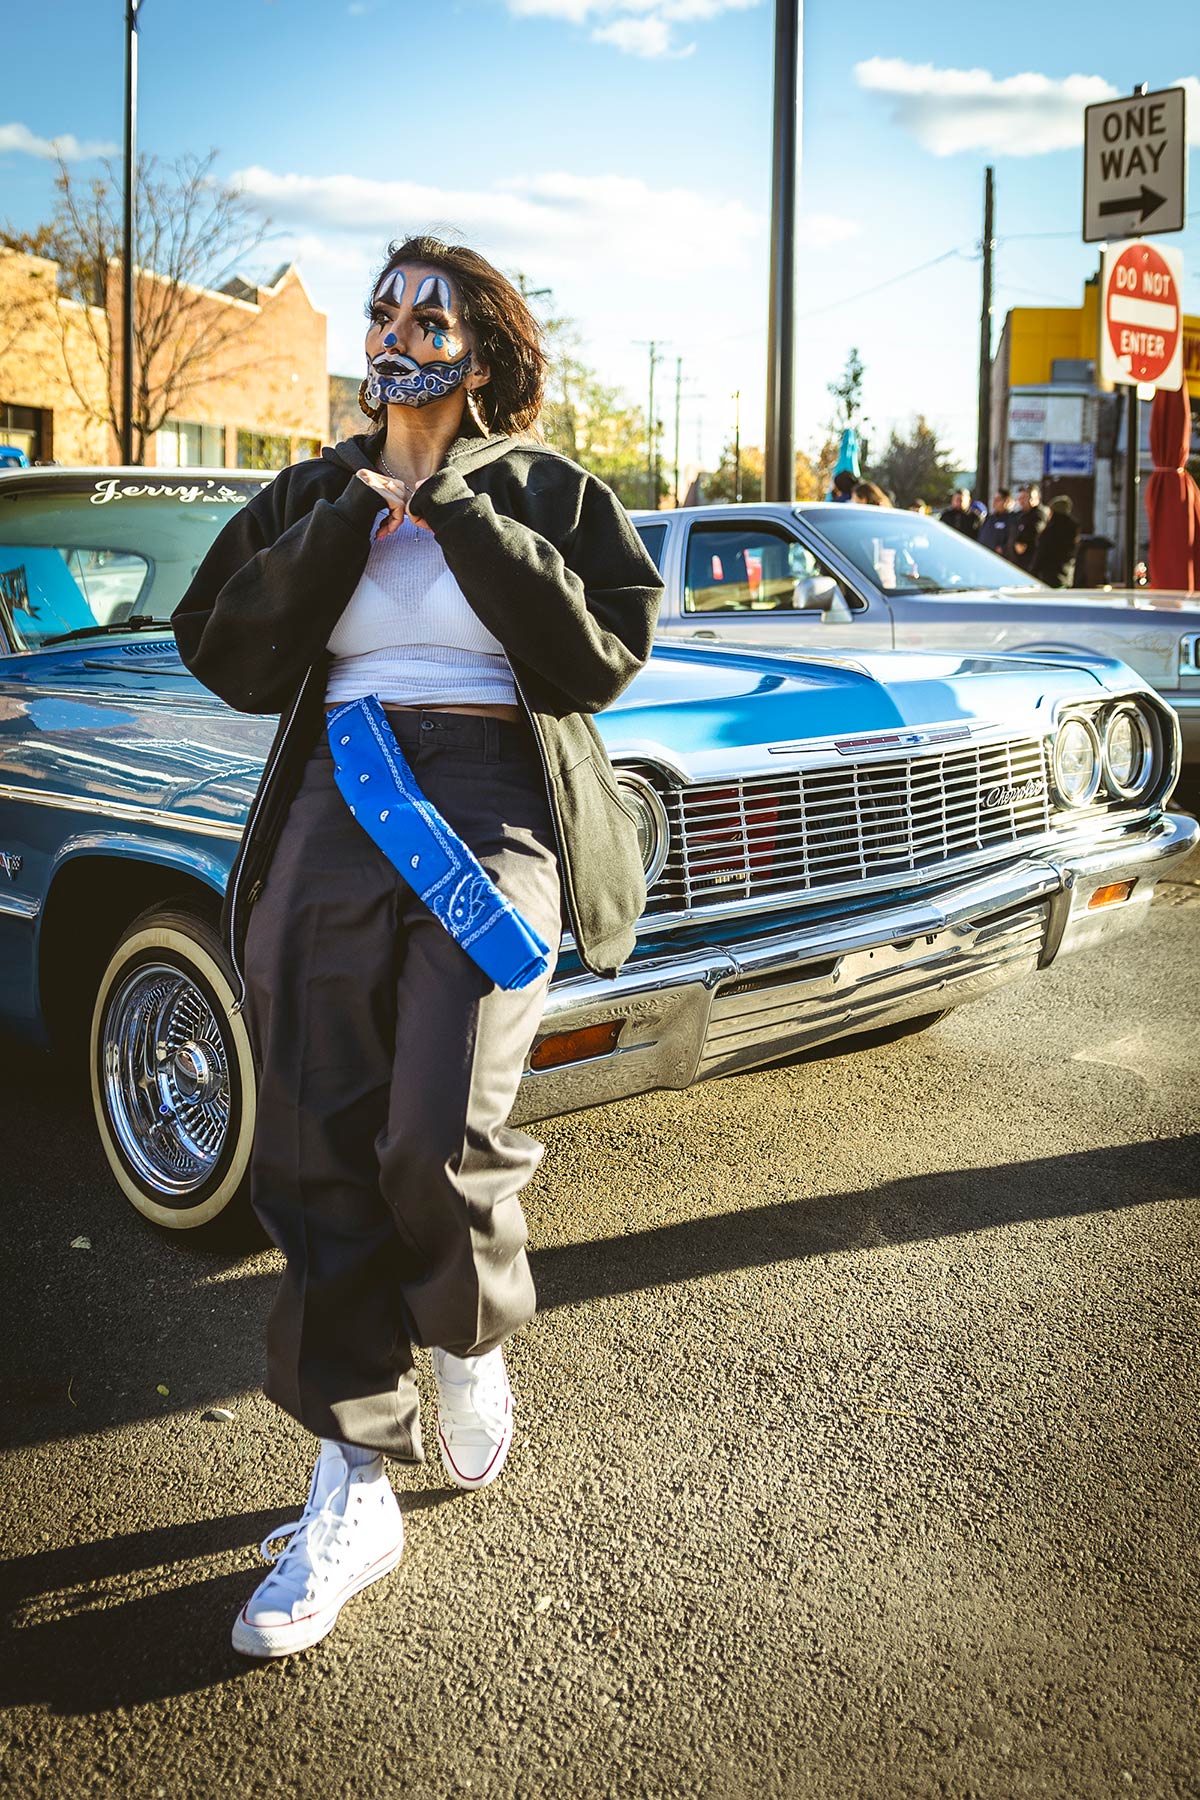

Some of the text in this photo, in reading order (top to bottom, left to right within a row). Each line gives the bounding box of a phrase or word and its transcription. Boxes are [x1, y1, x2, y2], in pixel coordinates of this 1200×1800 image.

[1103, 104, 1166, 143] ONE
[1101, 142, 1167, 181] WAY
[1116, 265, 1170, 296] DO NOT
[1120, 330, 1165, 358] ENTER
[90, 479, 236, 505] Jerry's
